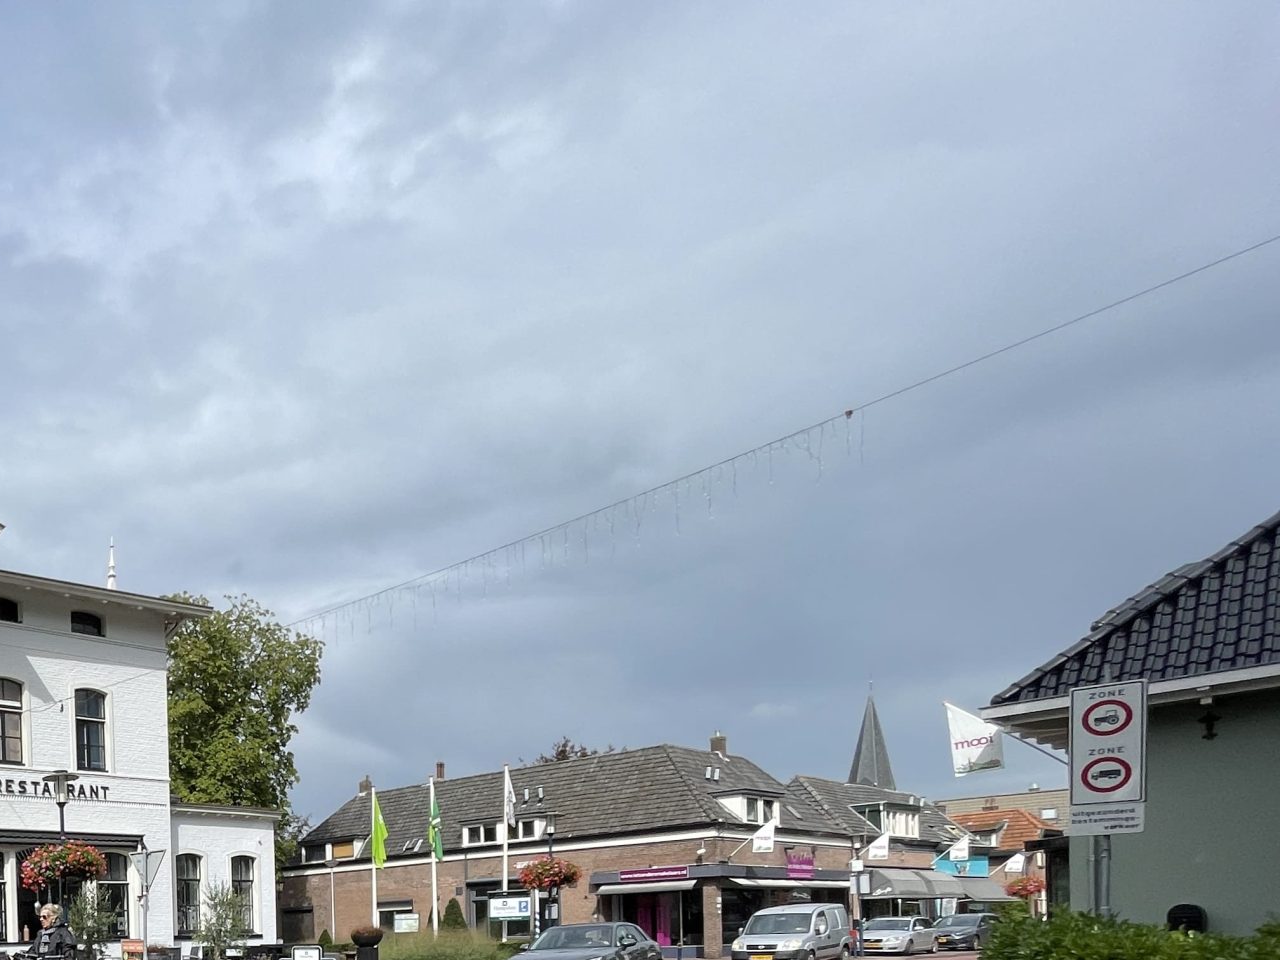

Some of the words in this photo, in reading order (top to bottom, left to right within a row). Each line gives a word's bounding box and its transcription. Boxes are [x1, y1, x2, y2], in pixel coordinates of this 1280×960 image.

[1088, 689, 1126, 699] ZONE
[954, 732, 993, 750] mooi
[1088, 746, 1125, 756] ZONE
